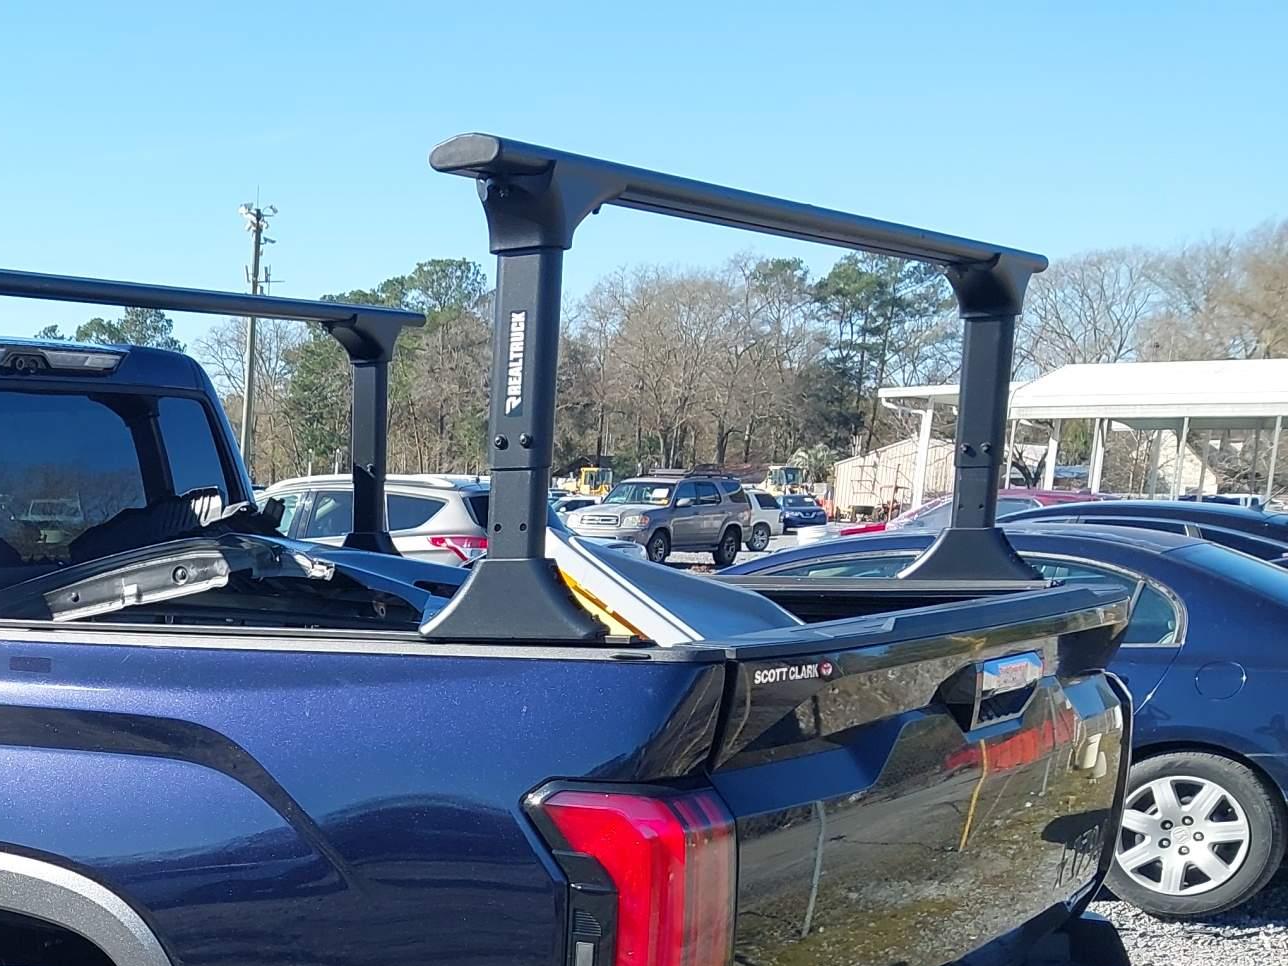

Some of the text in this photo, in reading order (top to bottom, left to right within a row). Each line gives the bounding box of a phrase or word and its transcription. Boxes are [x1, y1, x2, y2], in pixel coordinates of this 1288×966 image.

[507, 311, 526, 396] REALTRUCK
[754, 663, 819, 685] SCOTT CLARK
